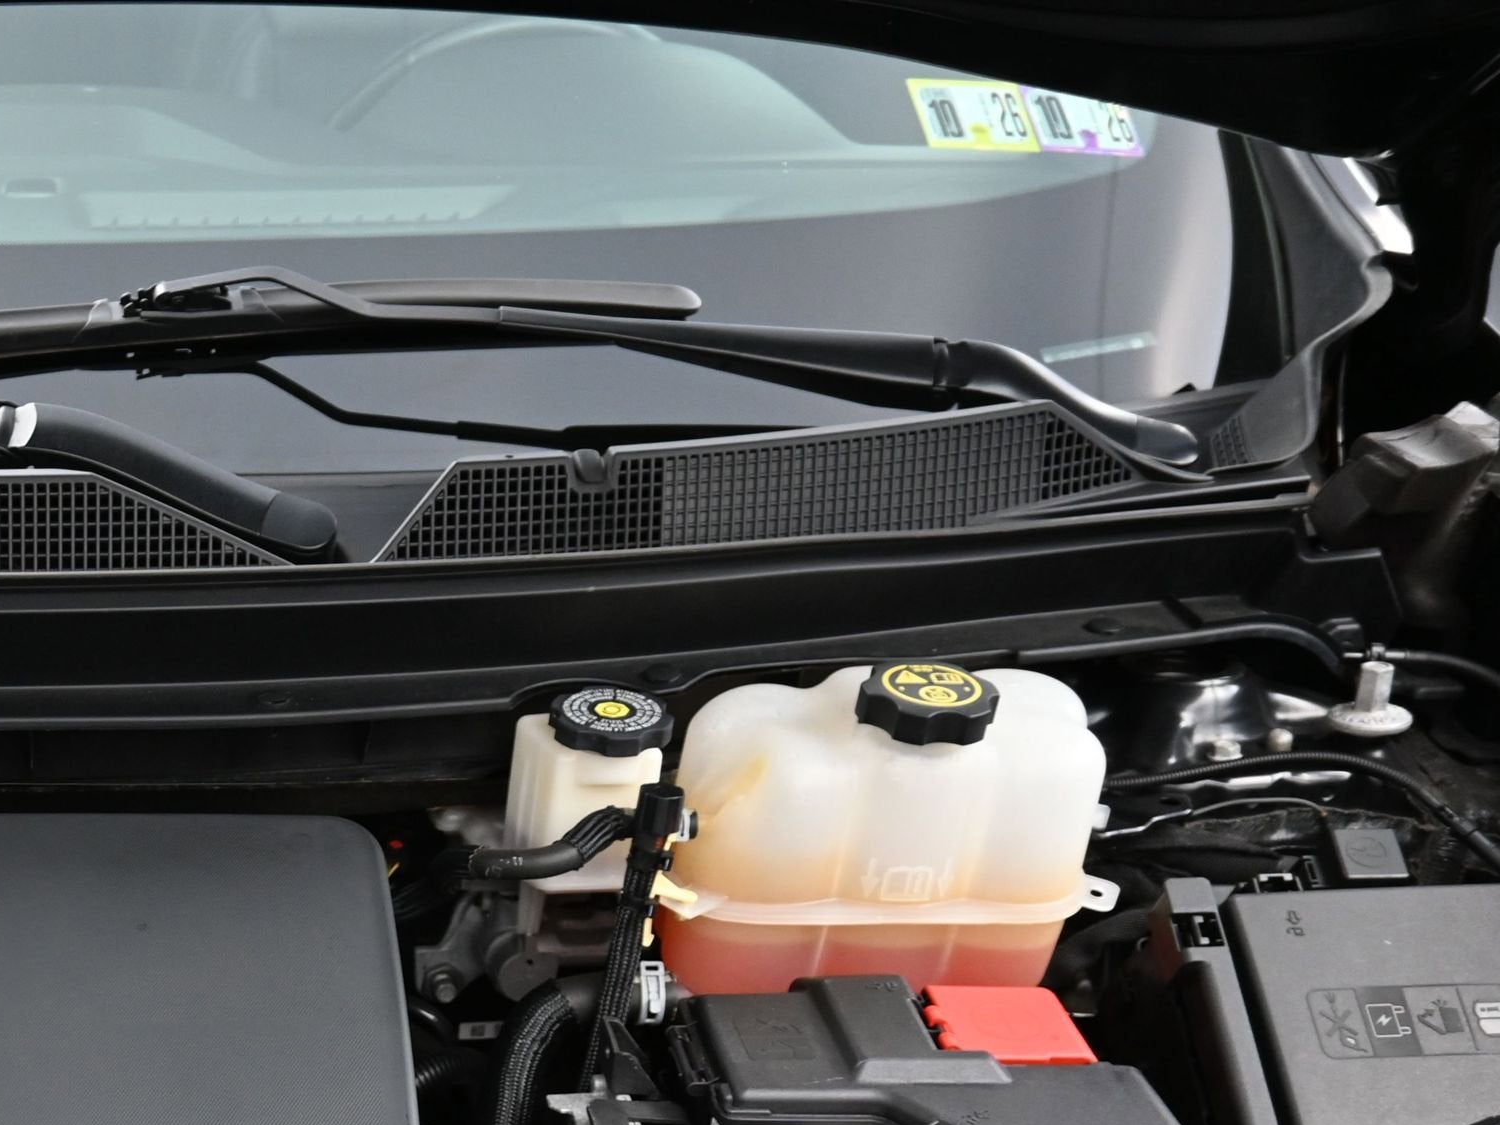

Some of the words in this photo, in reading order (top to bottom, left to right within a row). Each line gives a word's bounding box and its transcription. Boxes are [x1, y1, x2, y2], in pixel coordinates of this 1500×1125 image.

[929, 99, 965, 138] 10
[991, 92, 1027, 137] 26
[1034, 96, 1072, 140] 10
